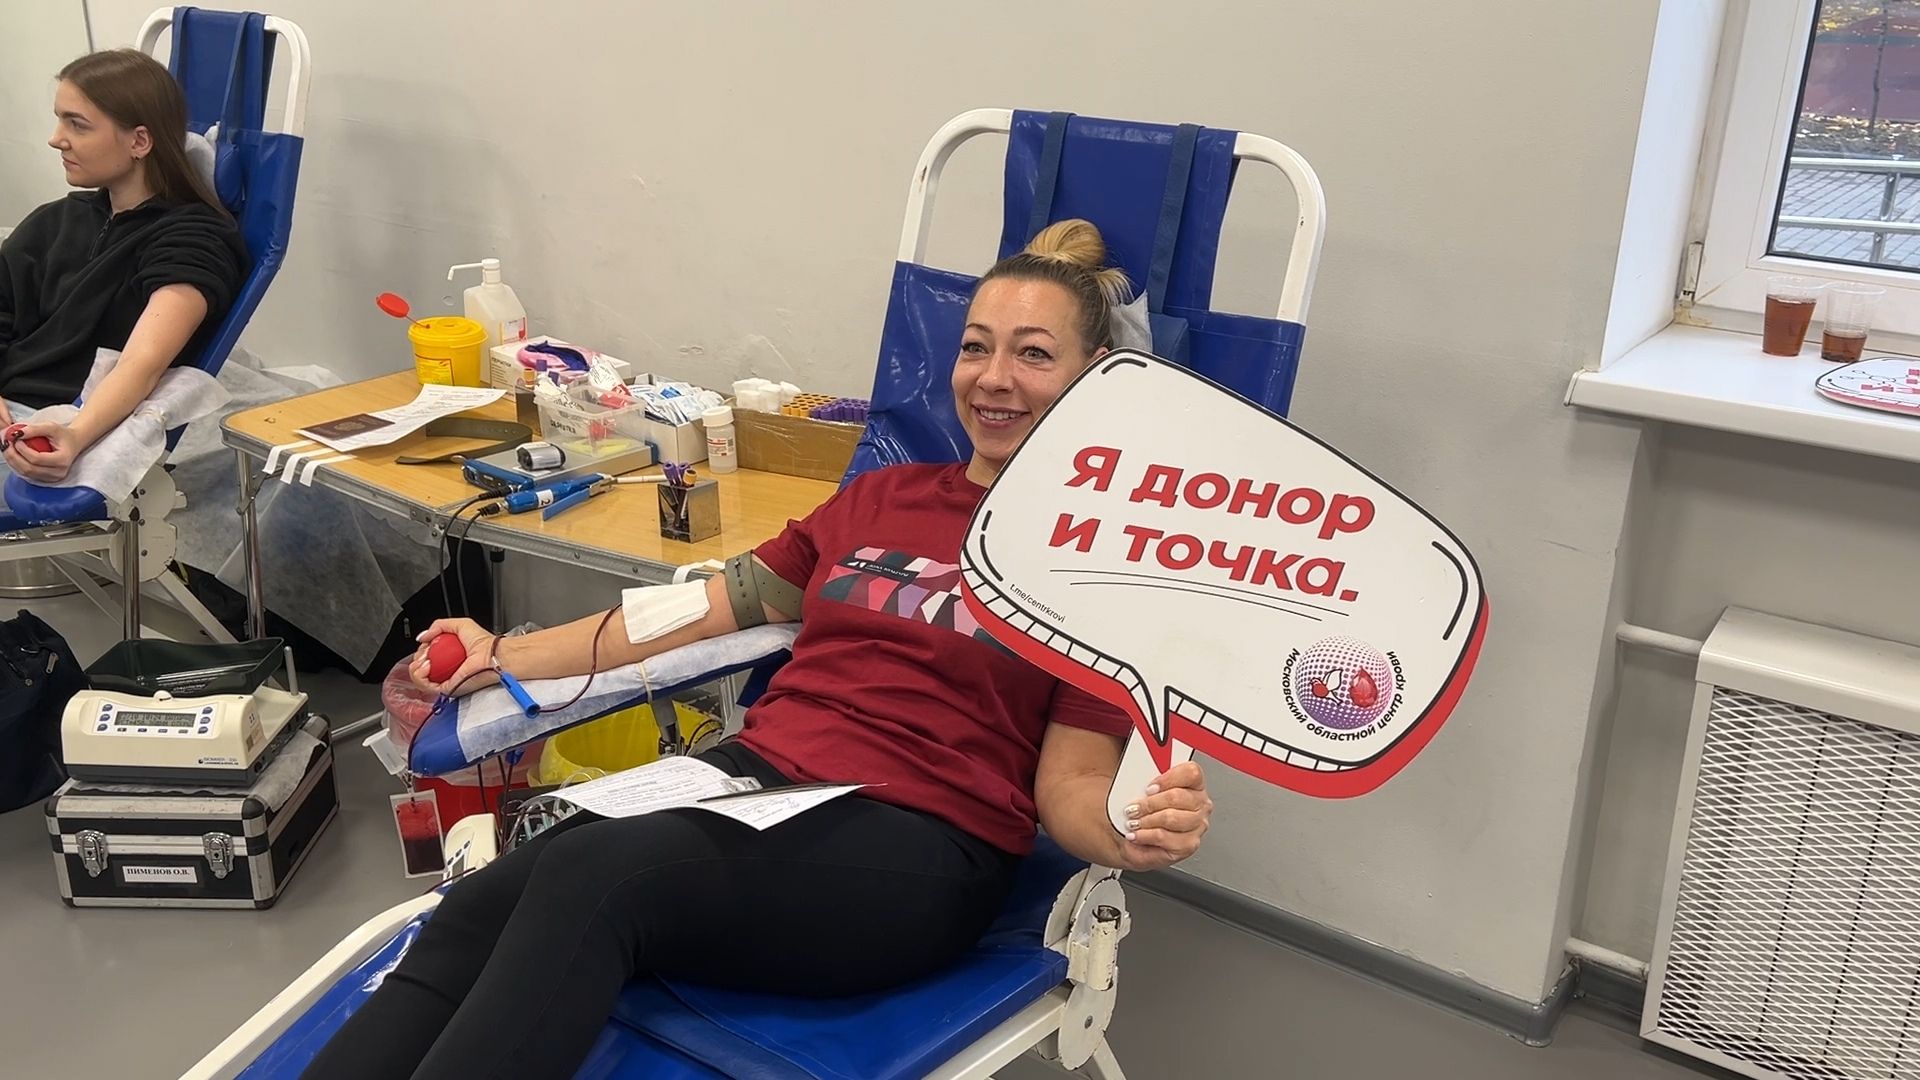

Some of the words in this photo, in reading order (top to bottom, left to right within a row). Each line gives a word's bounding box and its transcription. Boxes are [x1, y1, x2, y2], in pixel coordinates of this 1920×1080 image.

[1064, 445, 1122, 493] Я
[1129, 464, 1375, 540] донор
[1049, 512, 1101, 553] и
[1123, 524, 1358, 602] точка.
[1009, 584, 1066, 623] t.me/centrkrovi
[1282, 648, 1309, 723] Московский
[1386, 650, 1406, 691] крови
[1377, 692, 1404, 729] центр
[1306, 722, 1376, 741] областной
